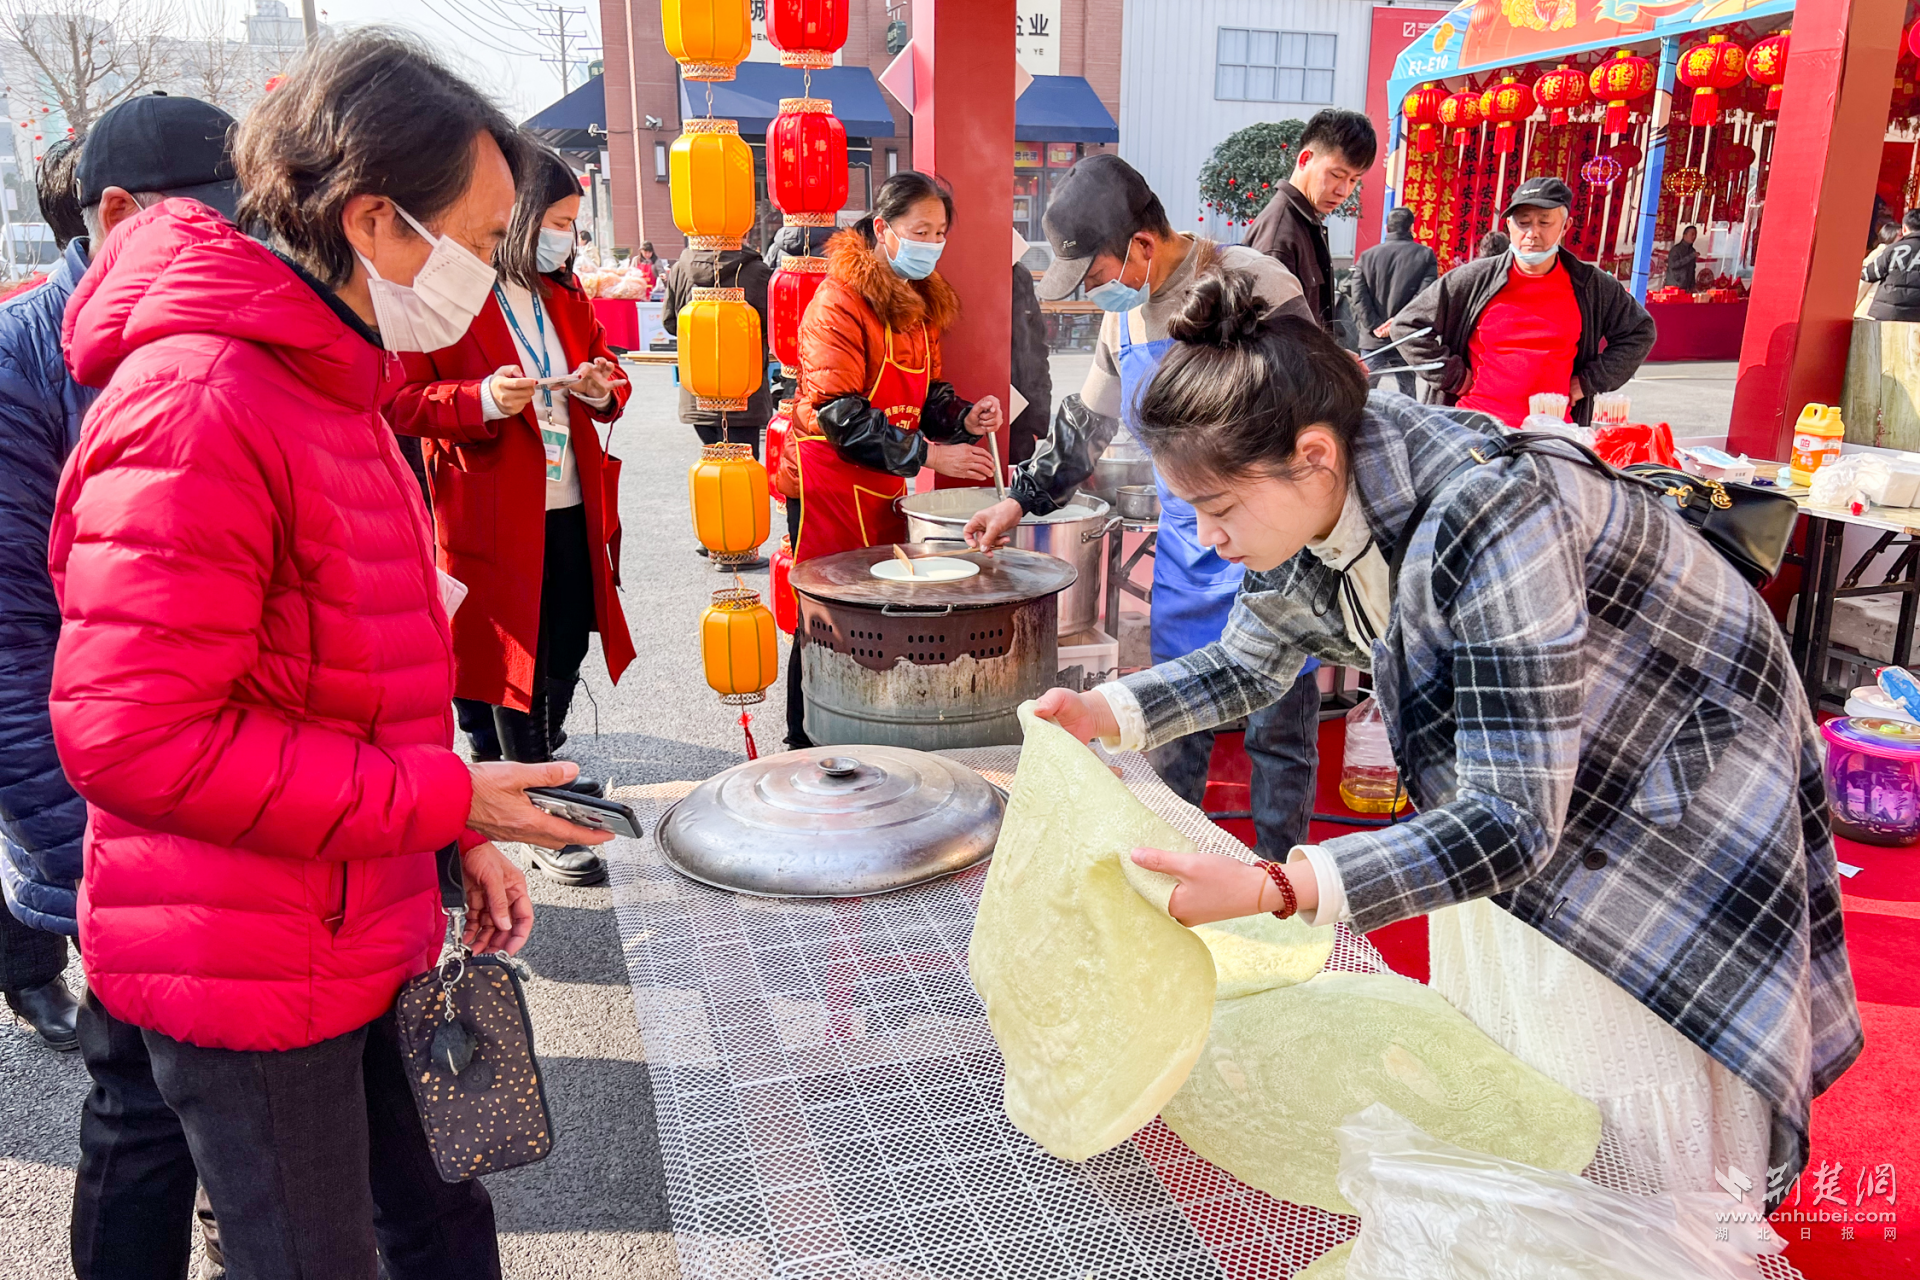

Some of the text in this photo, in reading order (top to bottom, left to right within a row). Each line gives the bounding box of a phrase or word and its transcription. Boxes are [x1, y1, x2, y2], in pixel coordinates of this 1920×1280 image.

[1033, 48, 1044, 56] YE
[1408, 54, 1448, 76] E1-E10
[1473, 130, 1498, 251] 四季平安福滿
